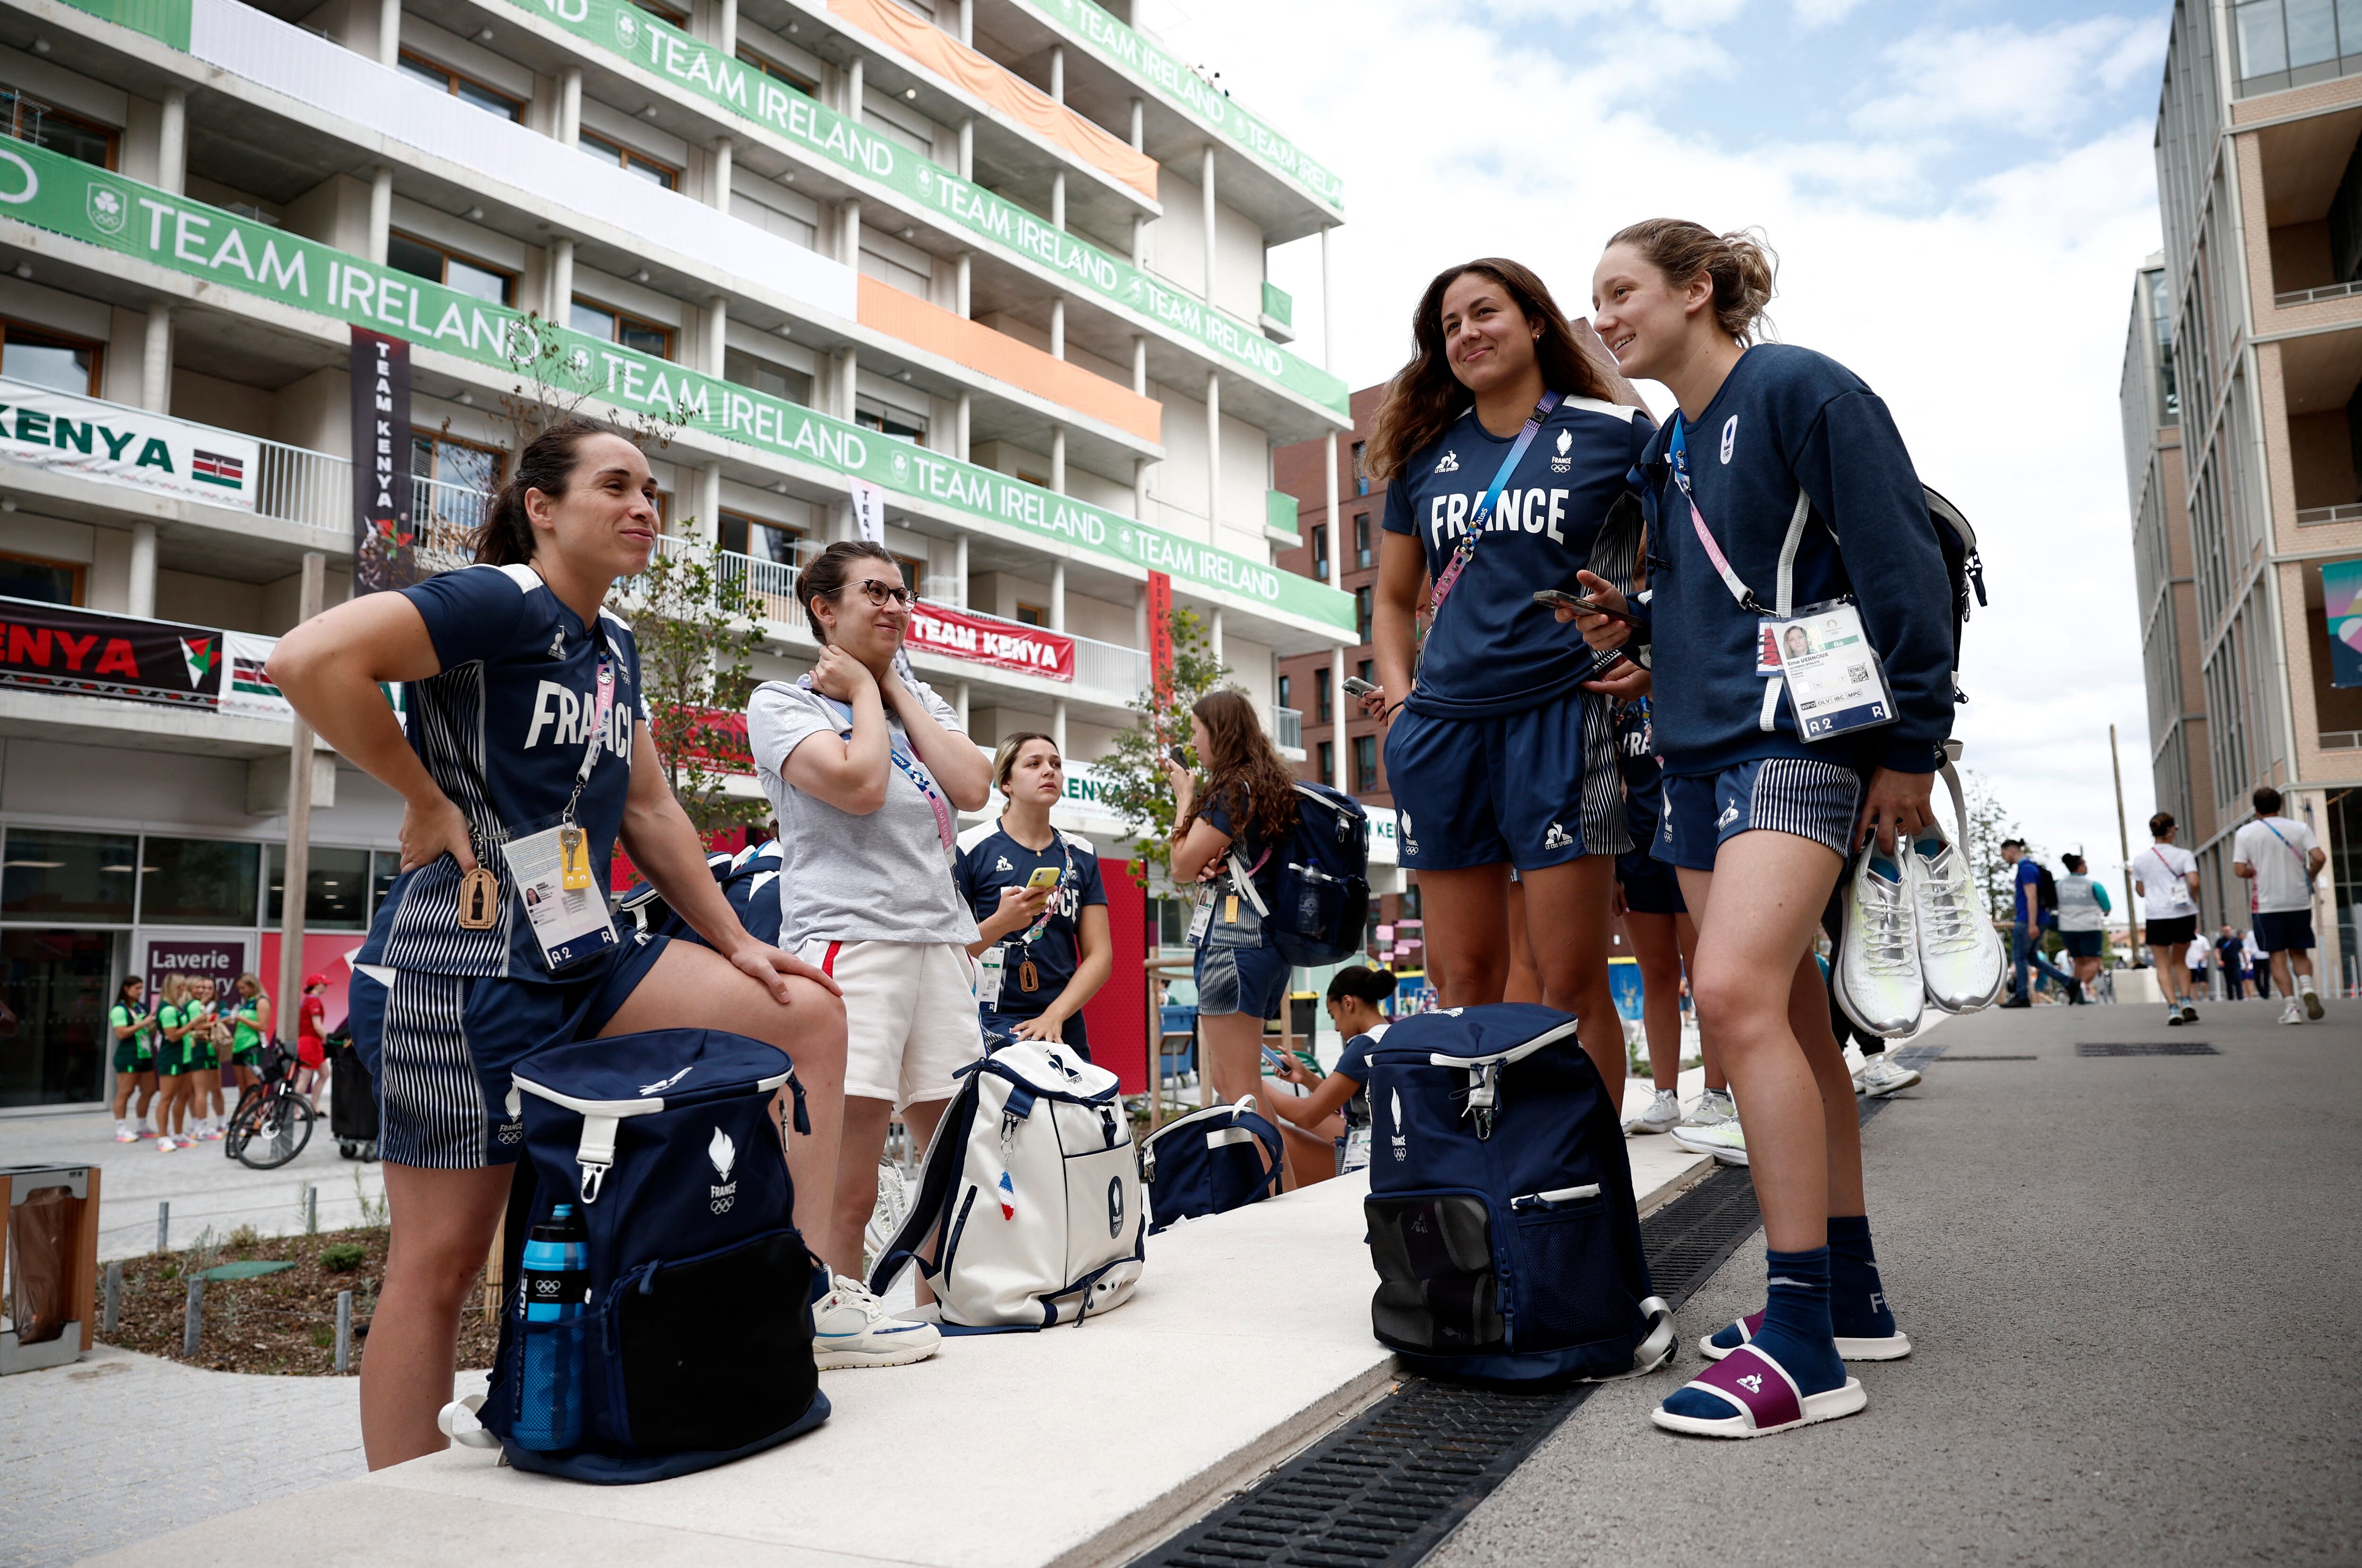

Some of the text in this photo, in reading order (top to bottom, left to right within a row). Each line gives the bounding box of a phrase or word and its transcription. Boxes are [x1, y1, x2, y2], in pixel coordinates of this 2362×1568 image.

[1077, 3, 1224, 123] TEAM IRELAND
[645, 24, 894, 176] TEAM IRELAND
[1247, 121, 1296, 172] TEAM
[937, 173, 1117, 291] TEAM IRELAND
[138, 197, 539, 365] TEAM IRELAND
[1146, 282, 1283, 377] TEAM IRELAND
[376, 341, 393, 509] TEAM KENYA
[601, 351, 867, 470] TEAM IRELAND
[913, 456, 1105, 545] TEAM IRELAND
[1431, 488, 1569, 552] FRANCE
[1476, 508, 1488, 525] Atos
[1136, 530, 1279, 600] TEAM IRELAND
[1695, 514, 1724, 568] PARIS 2024
[0, 622, 139, 678] NYA
[910, 614, 1058, 669] TEAM KENYA
[1800, 652, 1829, 664] VERNOUX
[1810, 706, 1883, 733] A 2 R
[892, 754, 907, 766] Atos
[935, 801, 950, 846] PARIS 2024
[1558, 839, 1574, 847] SPORTIF
[152, 950, 230, 969] Laverie
[551, 931, 612, 963] A 2 R
[499, 1122, 523, 1132] FRANCE
[1391, 1134, 1406, 1146] FRANCE
[710, 1181, 737, 1198] FRANCE
